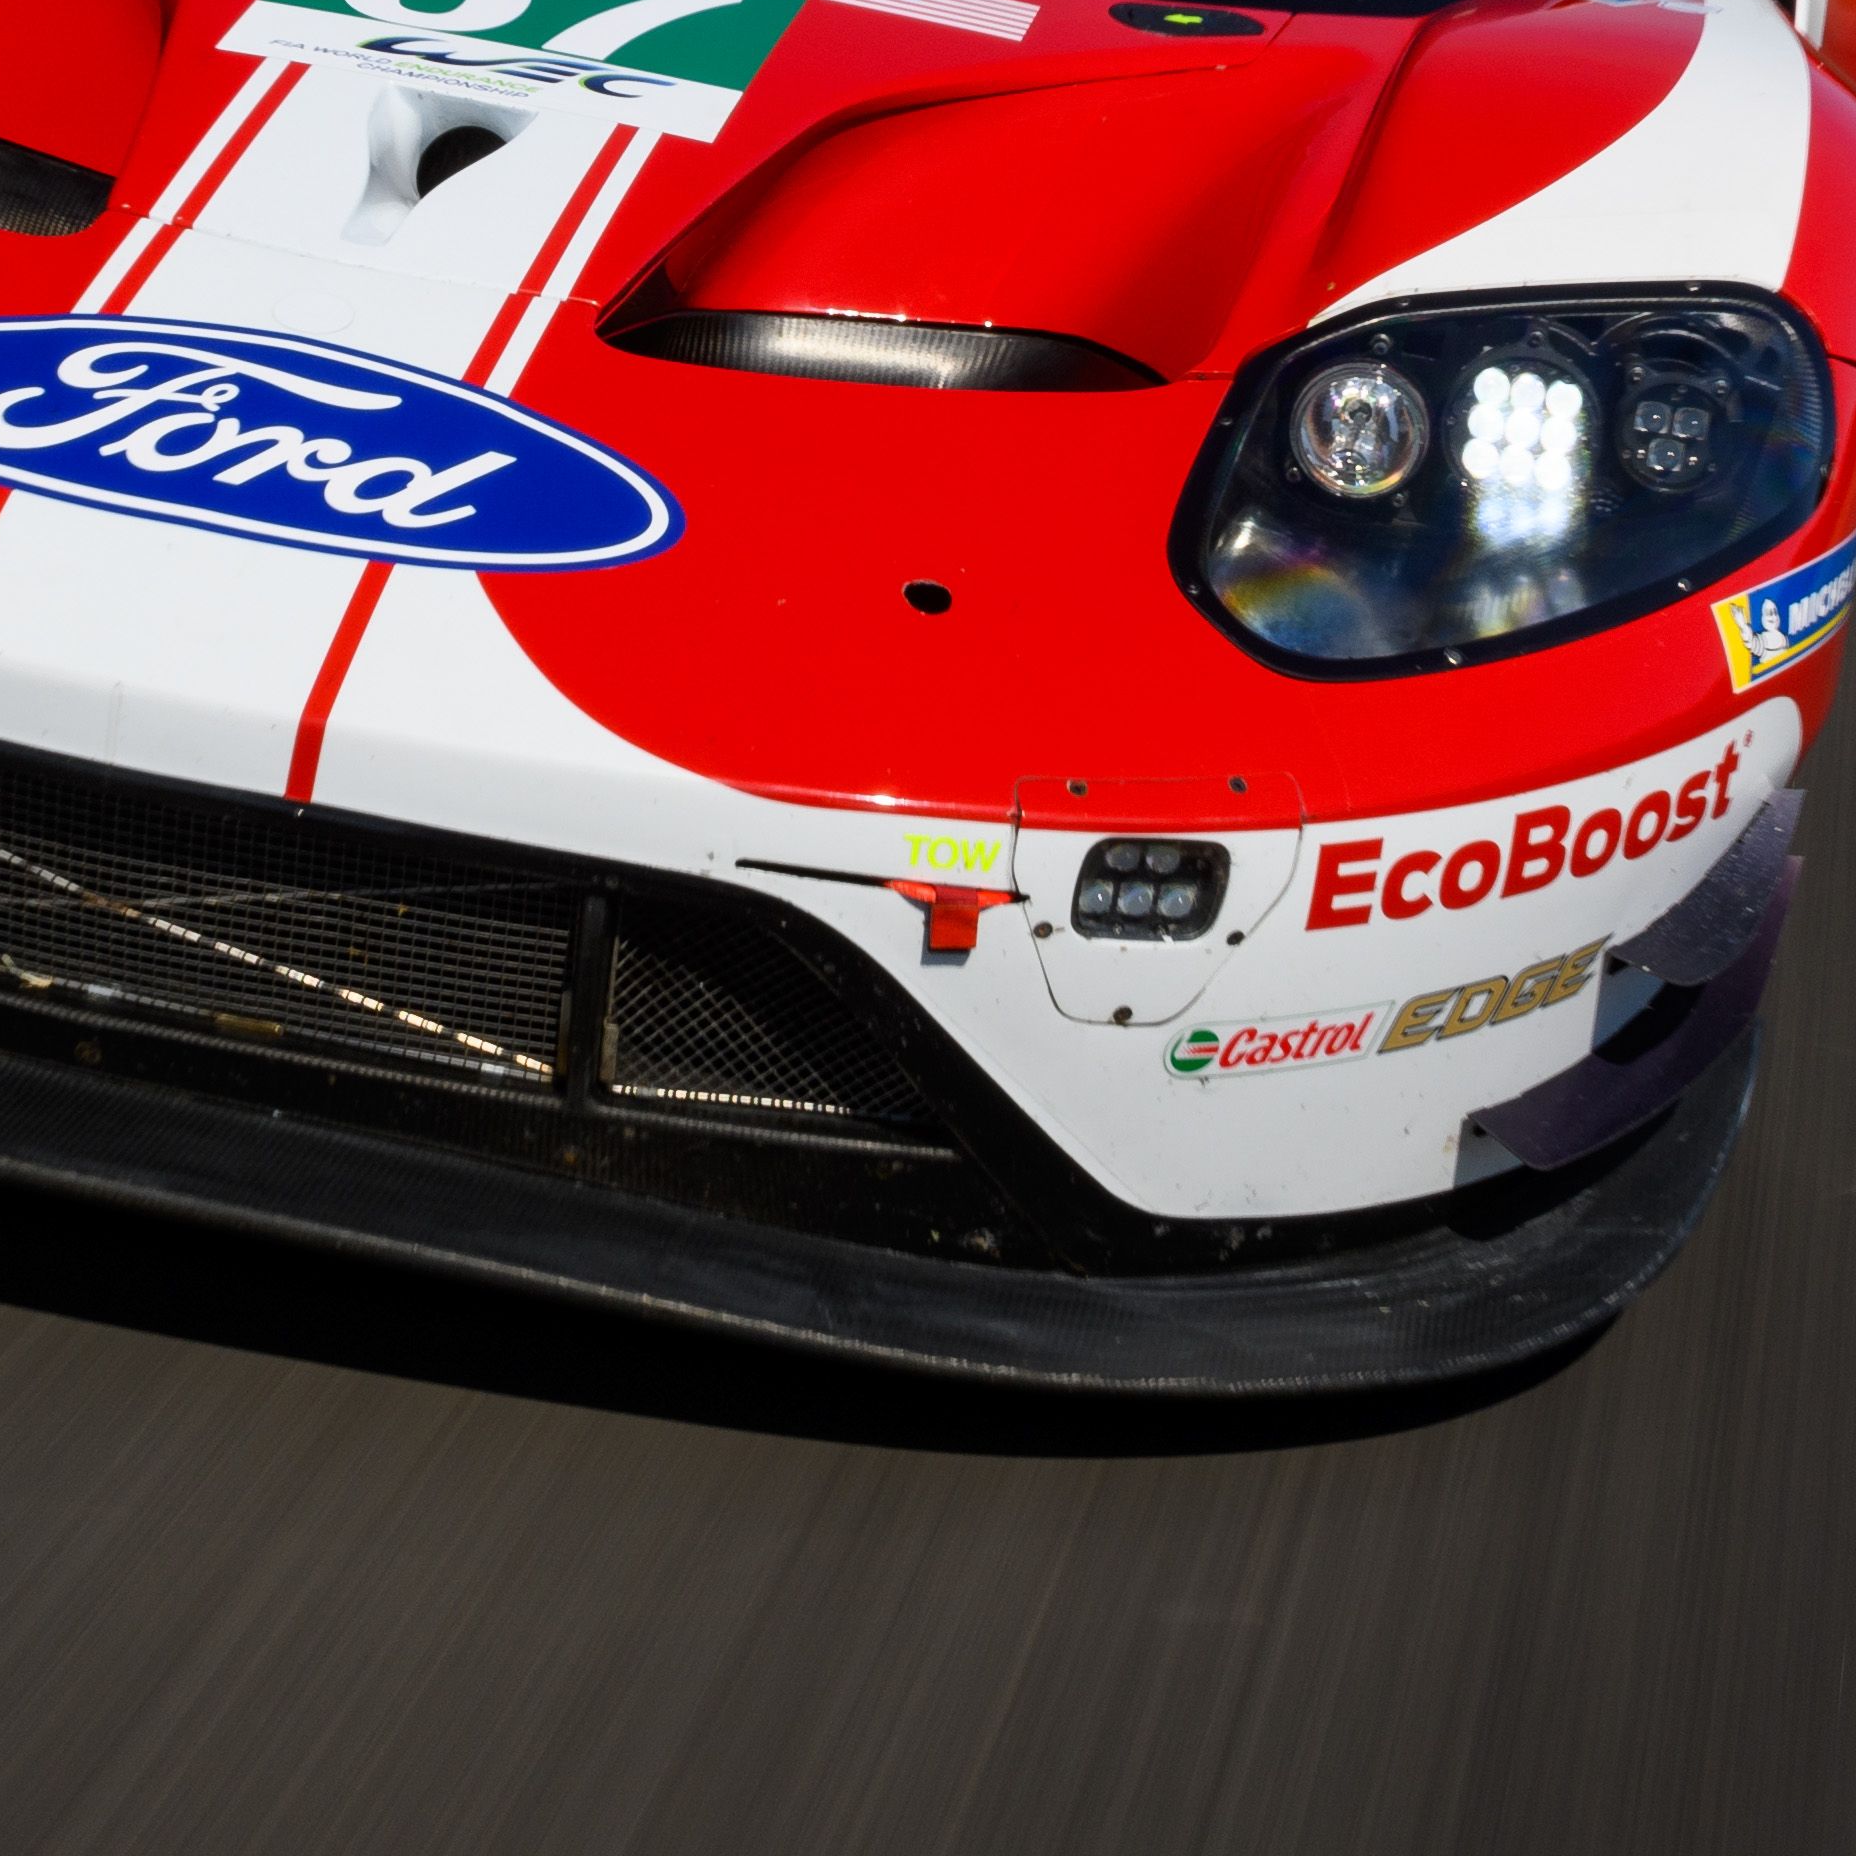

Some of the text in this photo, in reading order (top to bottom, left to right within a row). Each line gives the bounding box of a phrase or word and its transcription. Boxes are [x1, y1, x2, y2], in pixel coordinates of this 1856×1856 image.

[267, 38, 543, 94] FIA WORLD ENDURANCE
[355, 35, 678, 99] WEC
[355, 61, 531, 100] CHAMPIONSHIP
[902, 832, 1002, 873] TOW
[1304, 737, 1742, 932] EcoBoost
[1218, 931, 1615, 1069] Castrol EDGE
